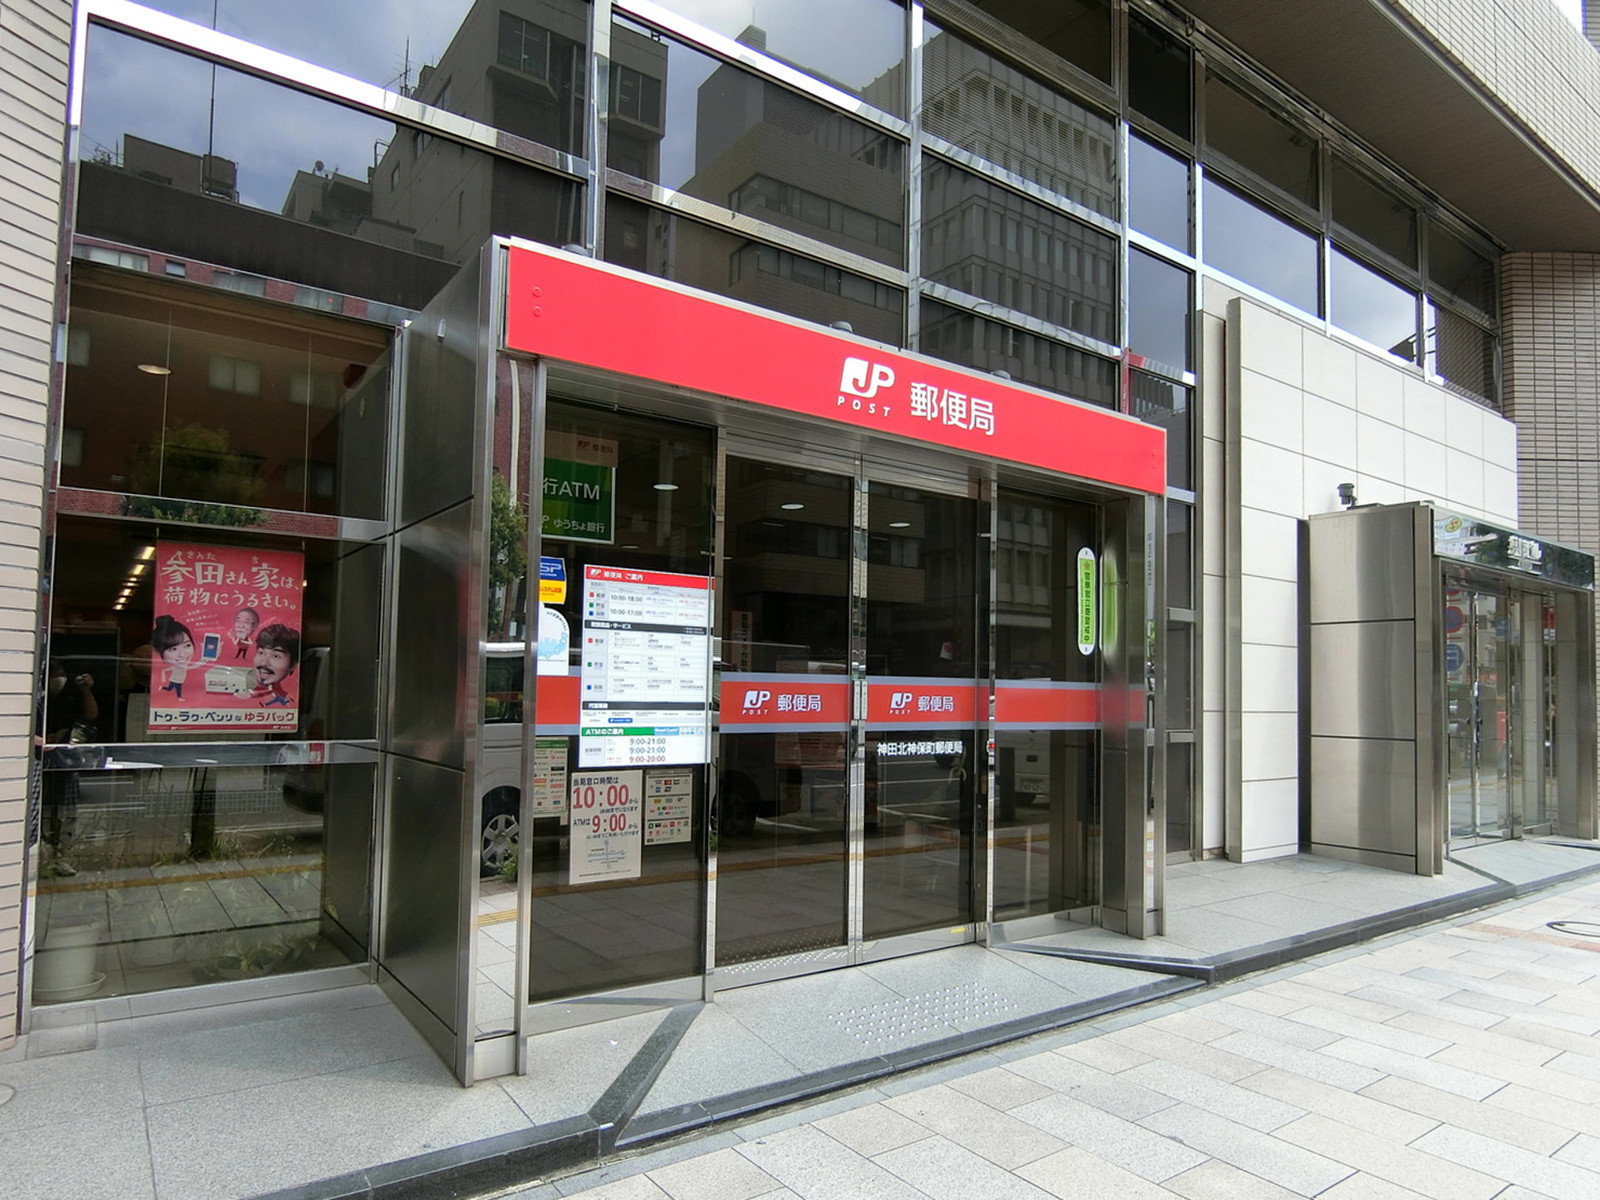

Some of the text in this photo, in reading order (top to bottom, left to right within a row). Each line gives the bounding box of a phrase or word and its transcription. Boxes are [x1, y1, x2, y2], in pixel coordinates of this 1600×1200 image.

[837, 395, 891, 417] POST
[910, 381, 995, 436] 郵便局
[553, 518, 606, 533] ゆうちょ銀行
[163, 586, 297, 610] 荷物にうるさい。
[610, 608, 643, 616] 10:00-17:00
[777, 694, 822, 712] 郵便局
[917, 695, 954, 712] 郵便局
[585, 728, 624, 736] ATMのご案内
[629, 737, 666, 745] 9:00-21:00
[877, 741, 963, 756] 神田北神保町郵便局
[629, 746, 666, 754] 9:00-21:00
[629, 755, 666, 763] 9:00-20:00
